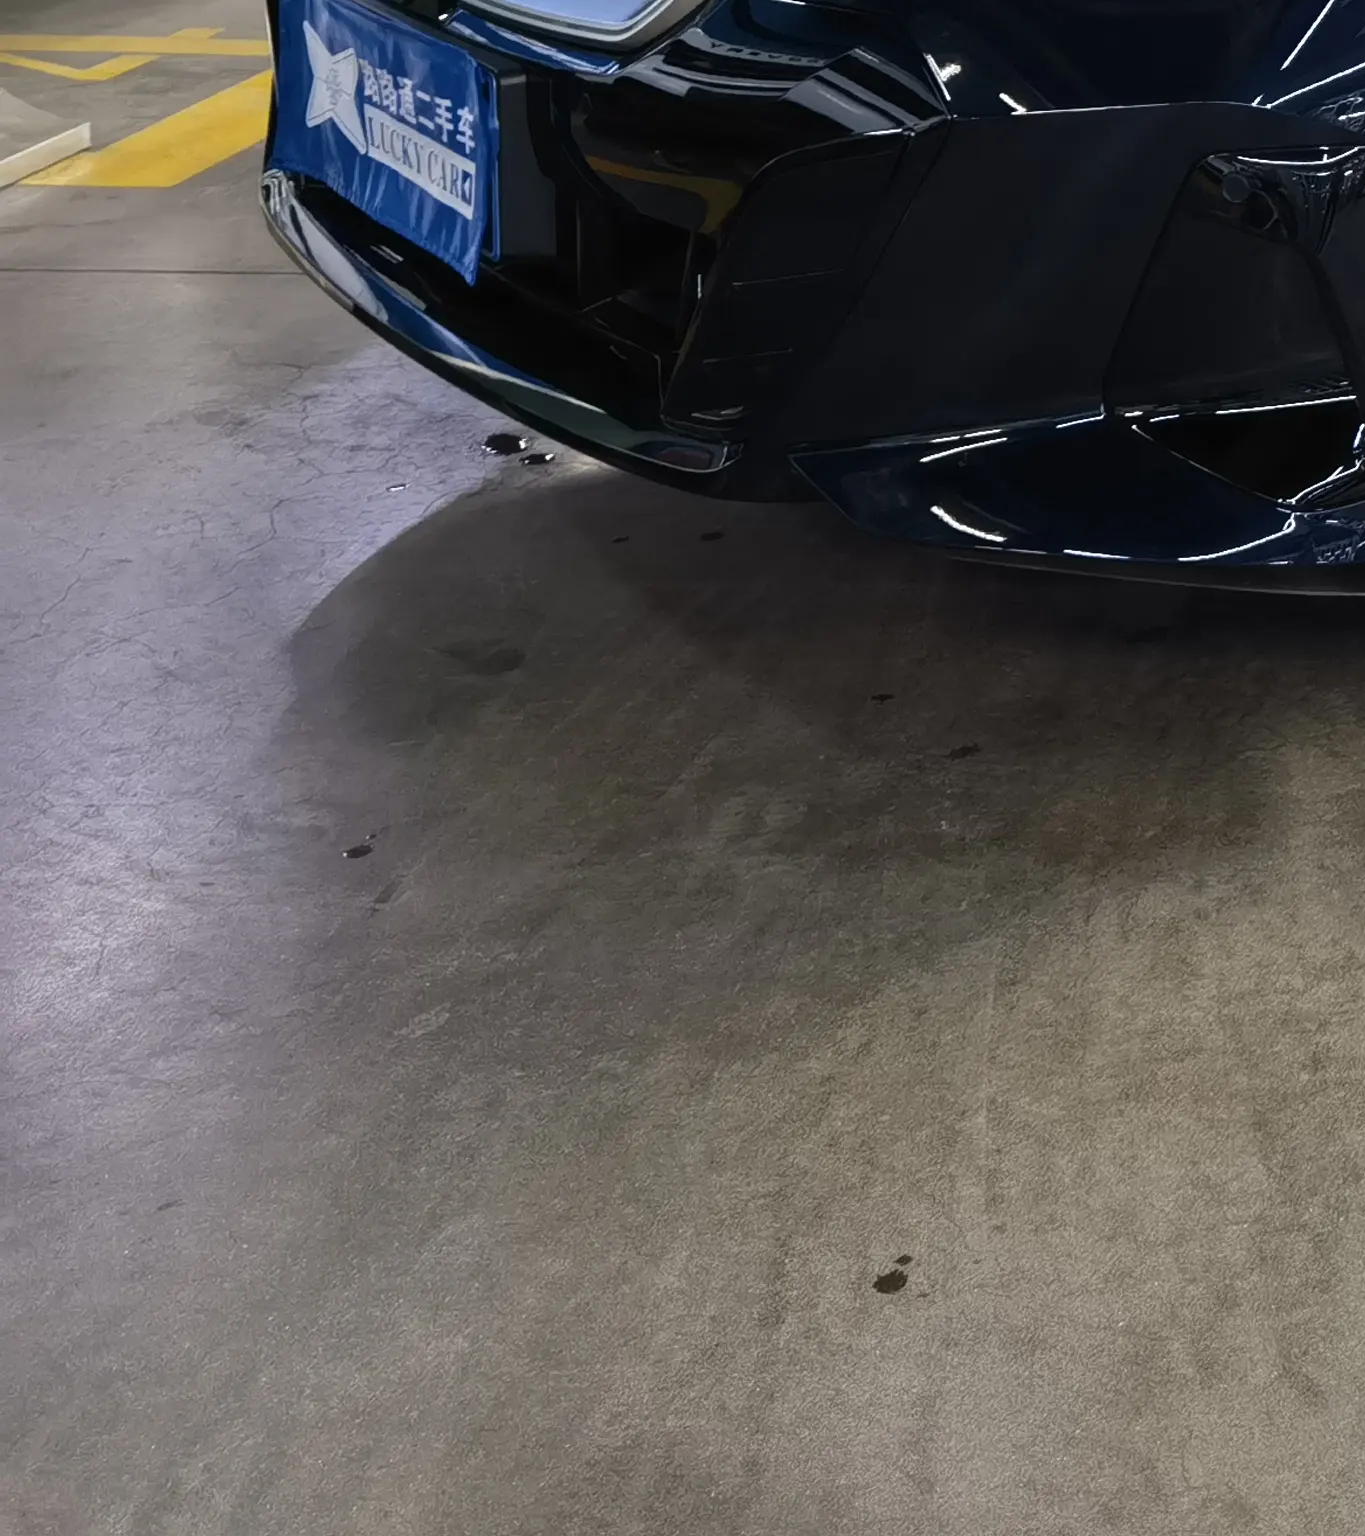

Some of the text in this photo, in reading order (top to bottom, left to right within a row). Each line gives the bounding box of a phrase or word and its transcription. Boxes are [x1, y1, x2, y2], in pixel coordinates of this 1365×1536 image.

[358, 57, 476, 155] 路路通二手车
[367, 115, 462, 200] LUCKY CAR
